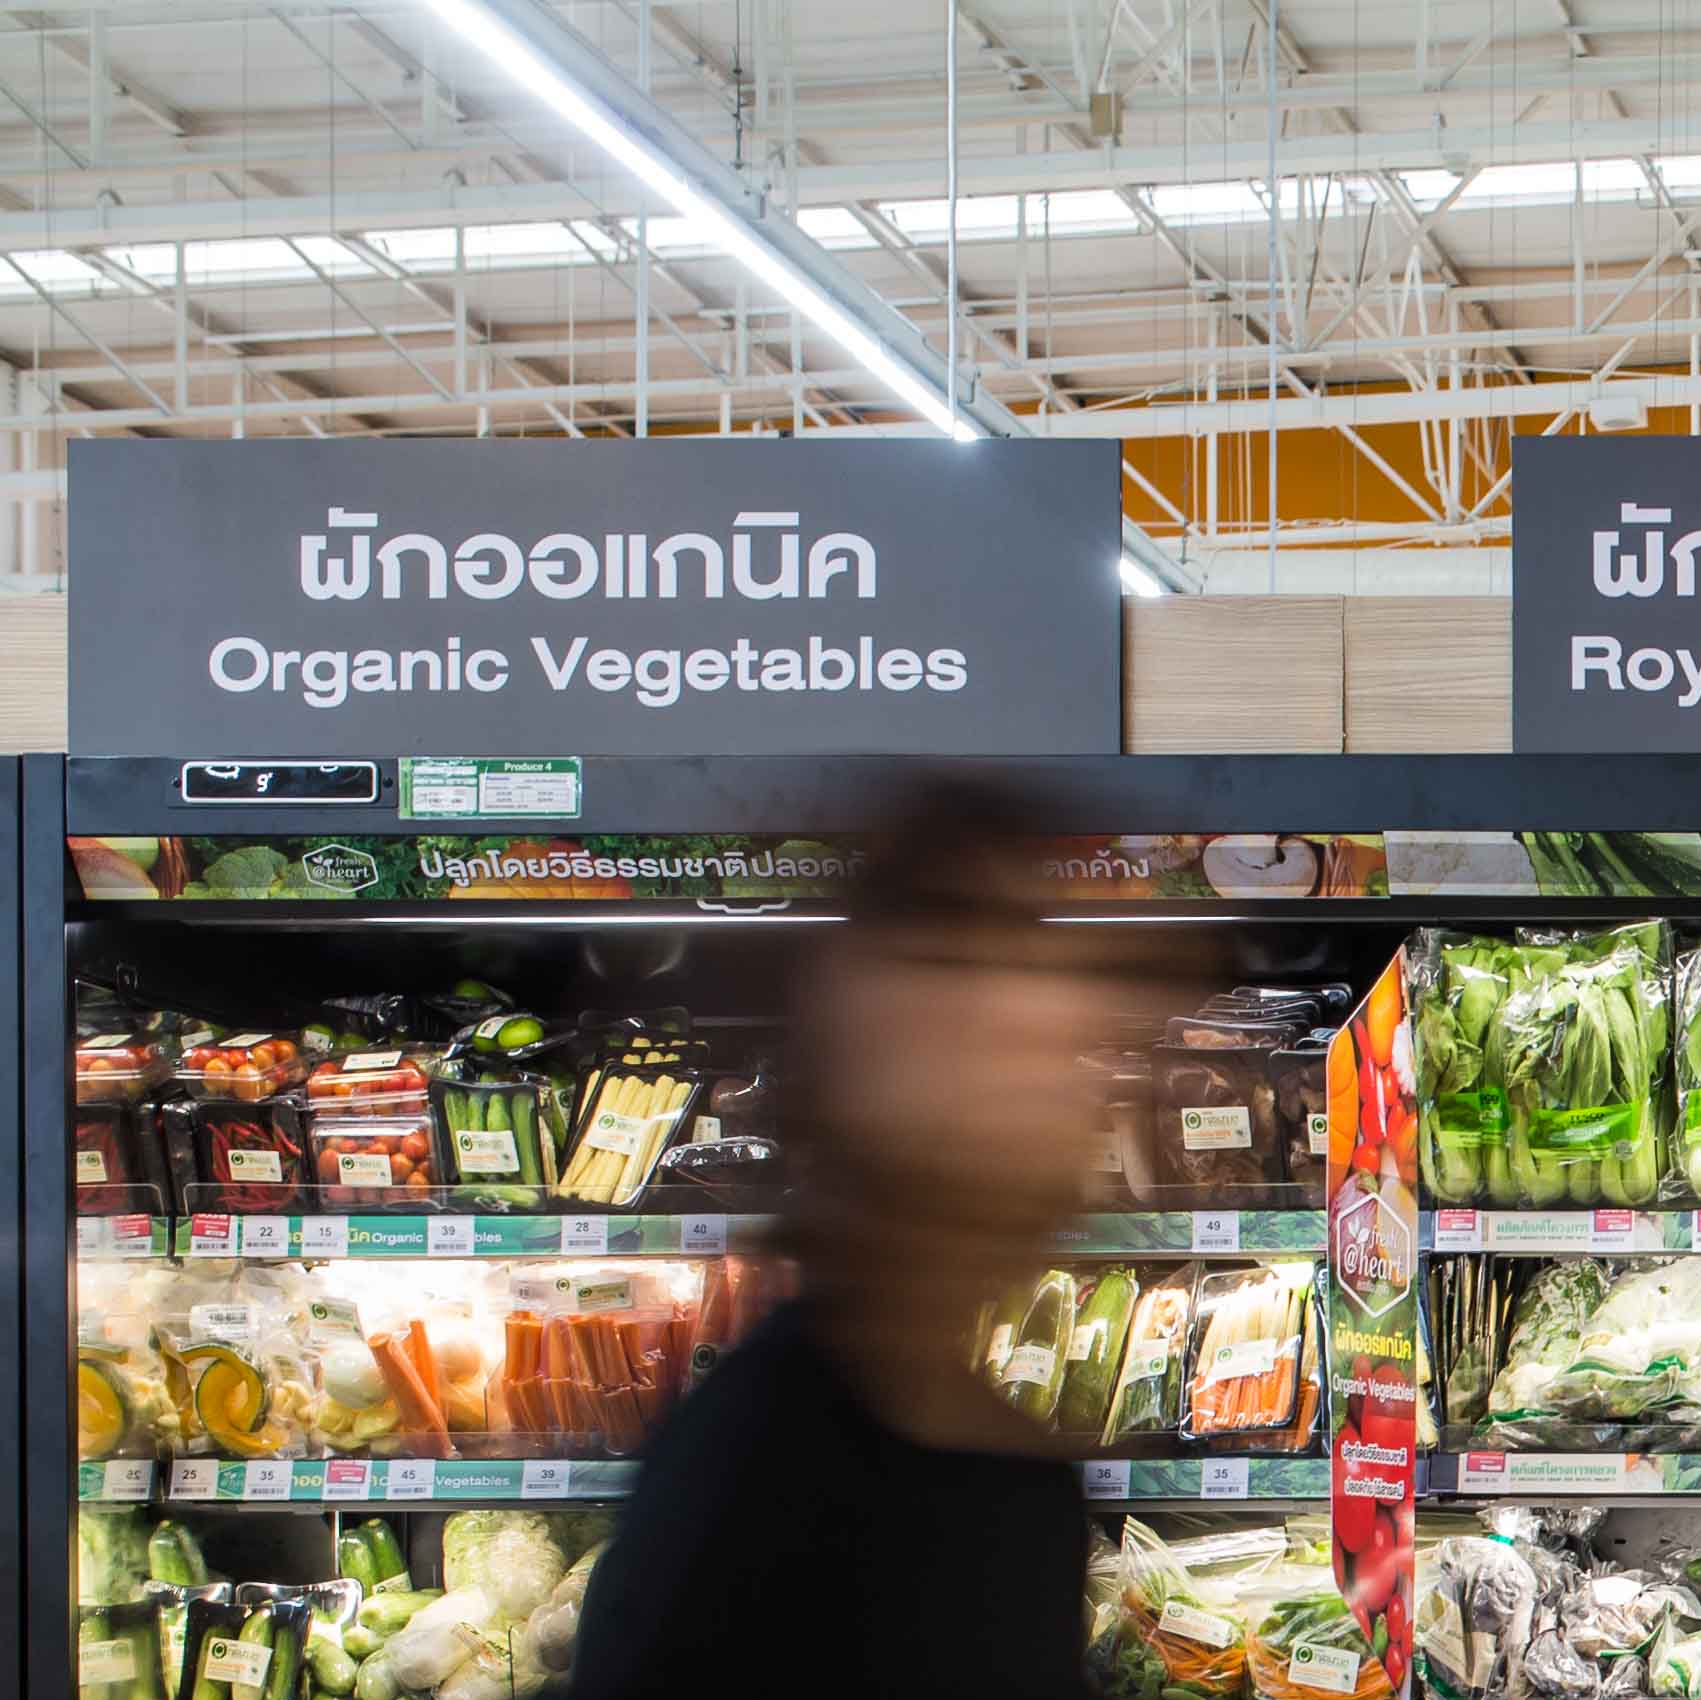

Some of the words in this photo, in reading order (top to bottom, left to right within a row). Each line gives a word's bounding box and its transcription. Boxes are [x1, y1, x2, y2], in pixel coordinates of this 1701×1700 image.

[207, 637, 510, 708] Organic
[531, 635, 968, 708] Vegetables
[504, 762, 544, 772] Produce
[312, 865, 369, 881] @heart
[442, 1226, 455, 1236] 39
[576, 1222, 589, 1232] 28
[1207, 1221, 1220, 1231] 49
[260, 1227, 272, 1237] 22
[320, 1227, 331, 1236] 15
[371, 1232, 424, 1246] Organic
[1332, 1373, 1367, 1398] Organic
[182, 1470, 196, 1480] 25
[261, 1471, 273, 1480] 35
[402, 1470, 415, 1479] 45
[541, 1470, 555, 1479] 39
[1096, 1469, 1111, 1479] 36
[1214, 1469, 1228, 1479] 35
[435, 1476, 510, 1490] Vegetables
